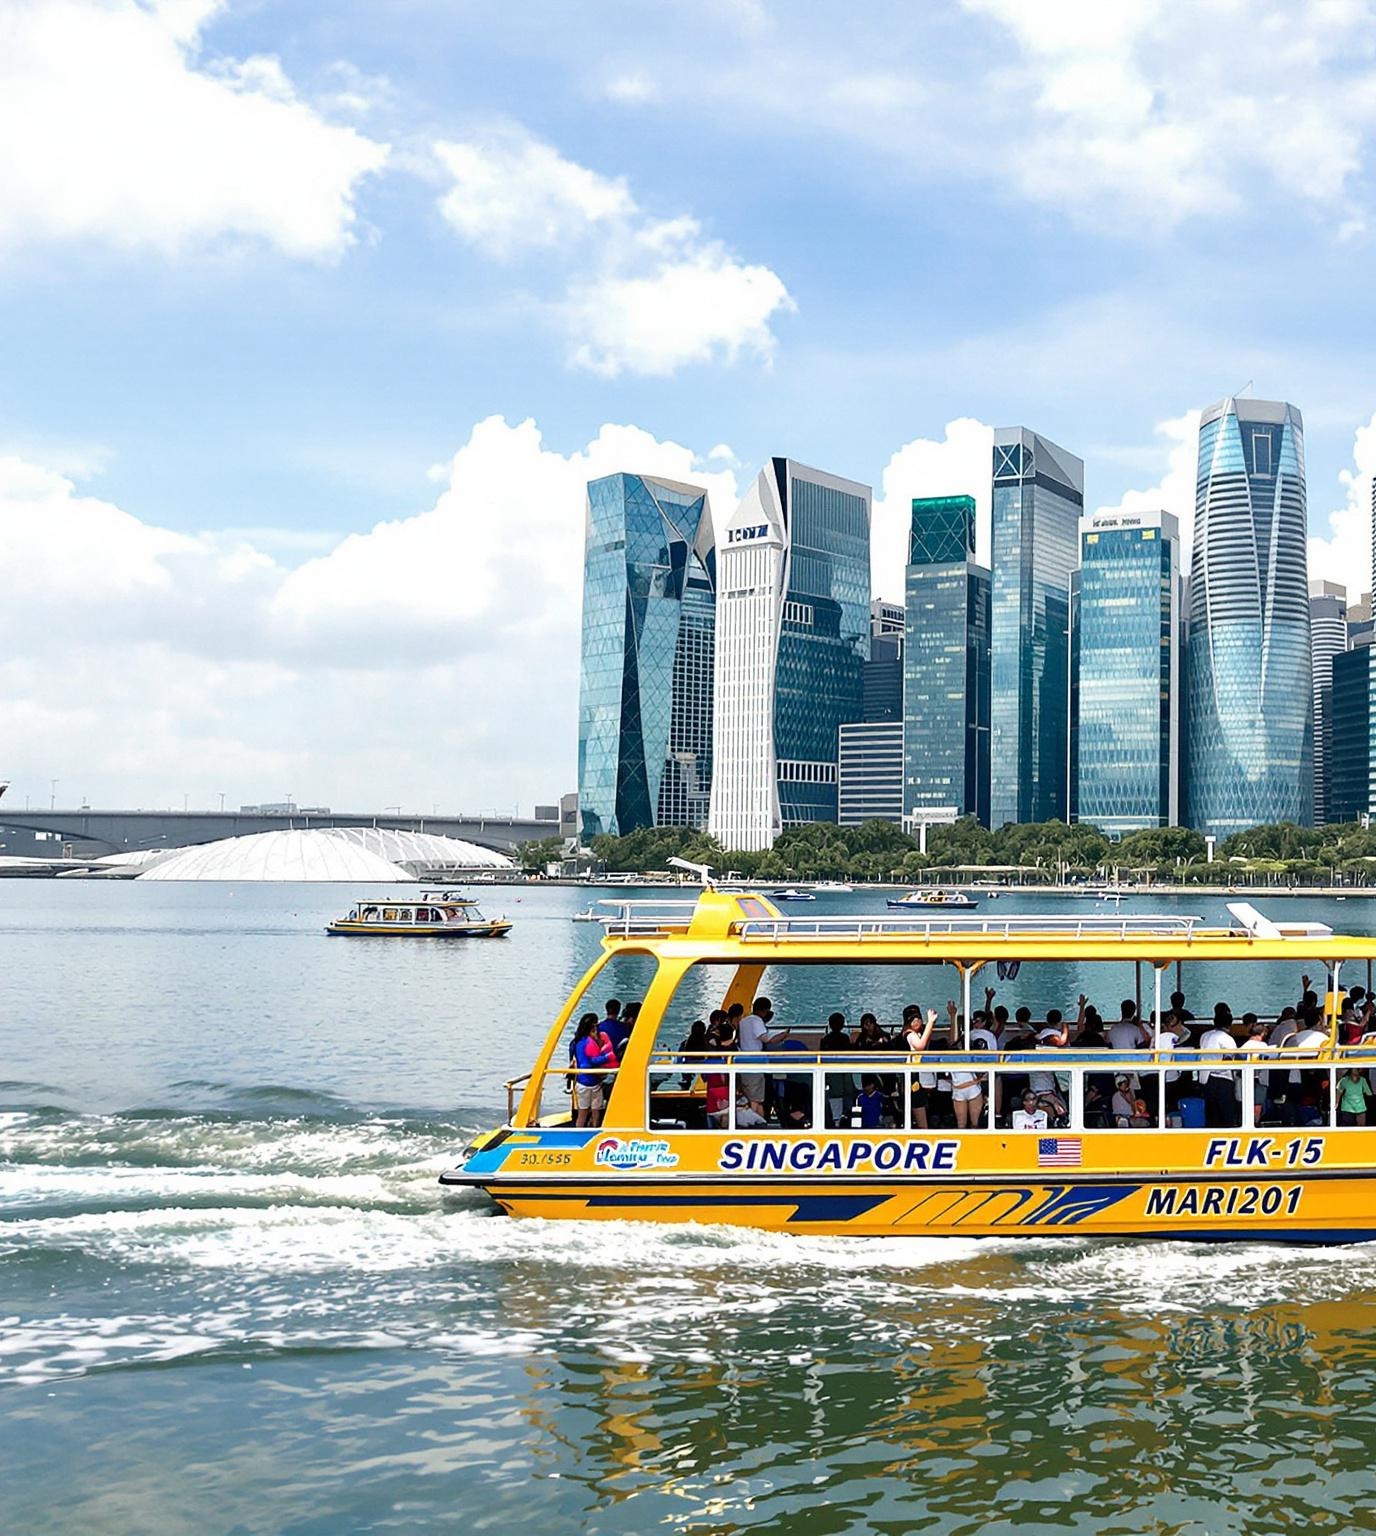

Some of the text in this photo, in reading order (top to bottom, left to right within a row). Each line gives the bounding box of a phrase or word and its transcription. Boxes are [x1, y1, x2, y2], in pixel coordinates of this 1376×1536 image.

[720, 1142, 958, 1170] SINGAPORE
[1206, 1138, 1324, 1165] FLK-15
[1146, 1186, 1303, 1215] MARI201
